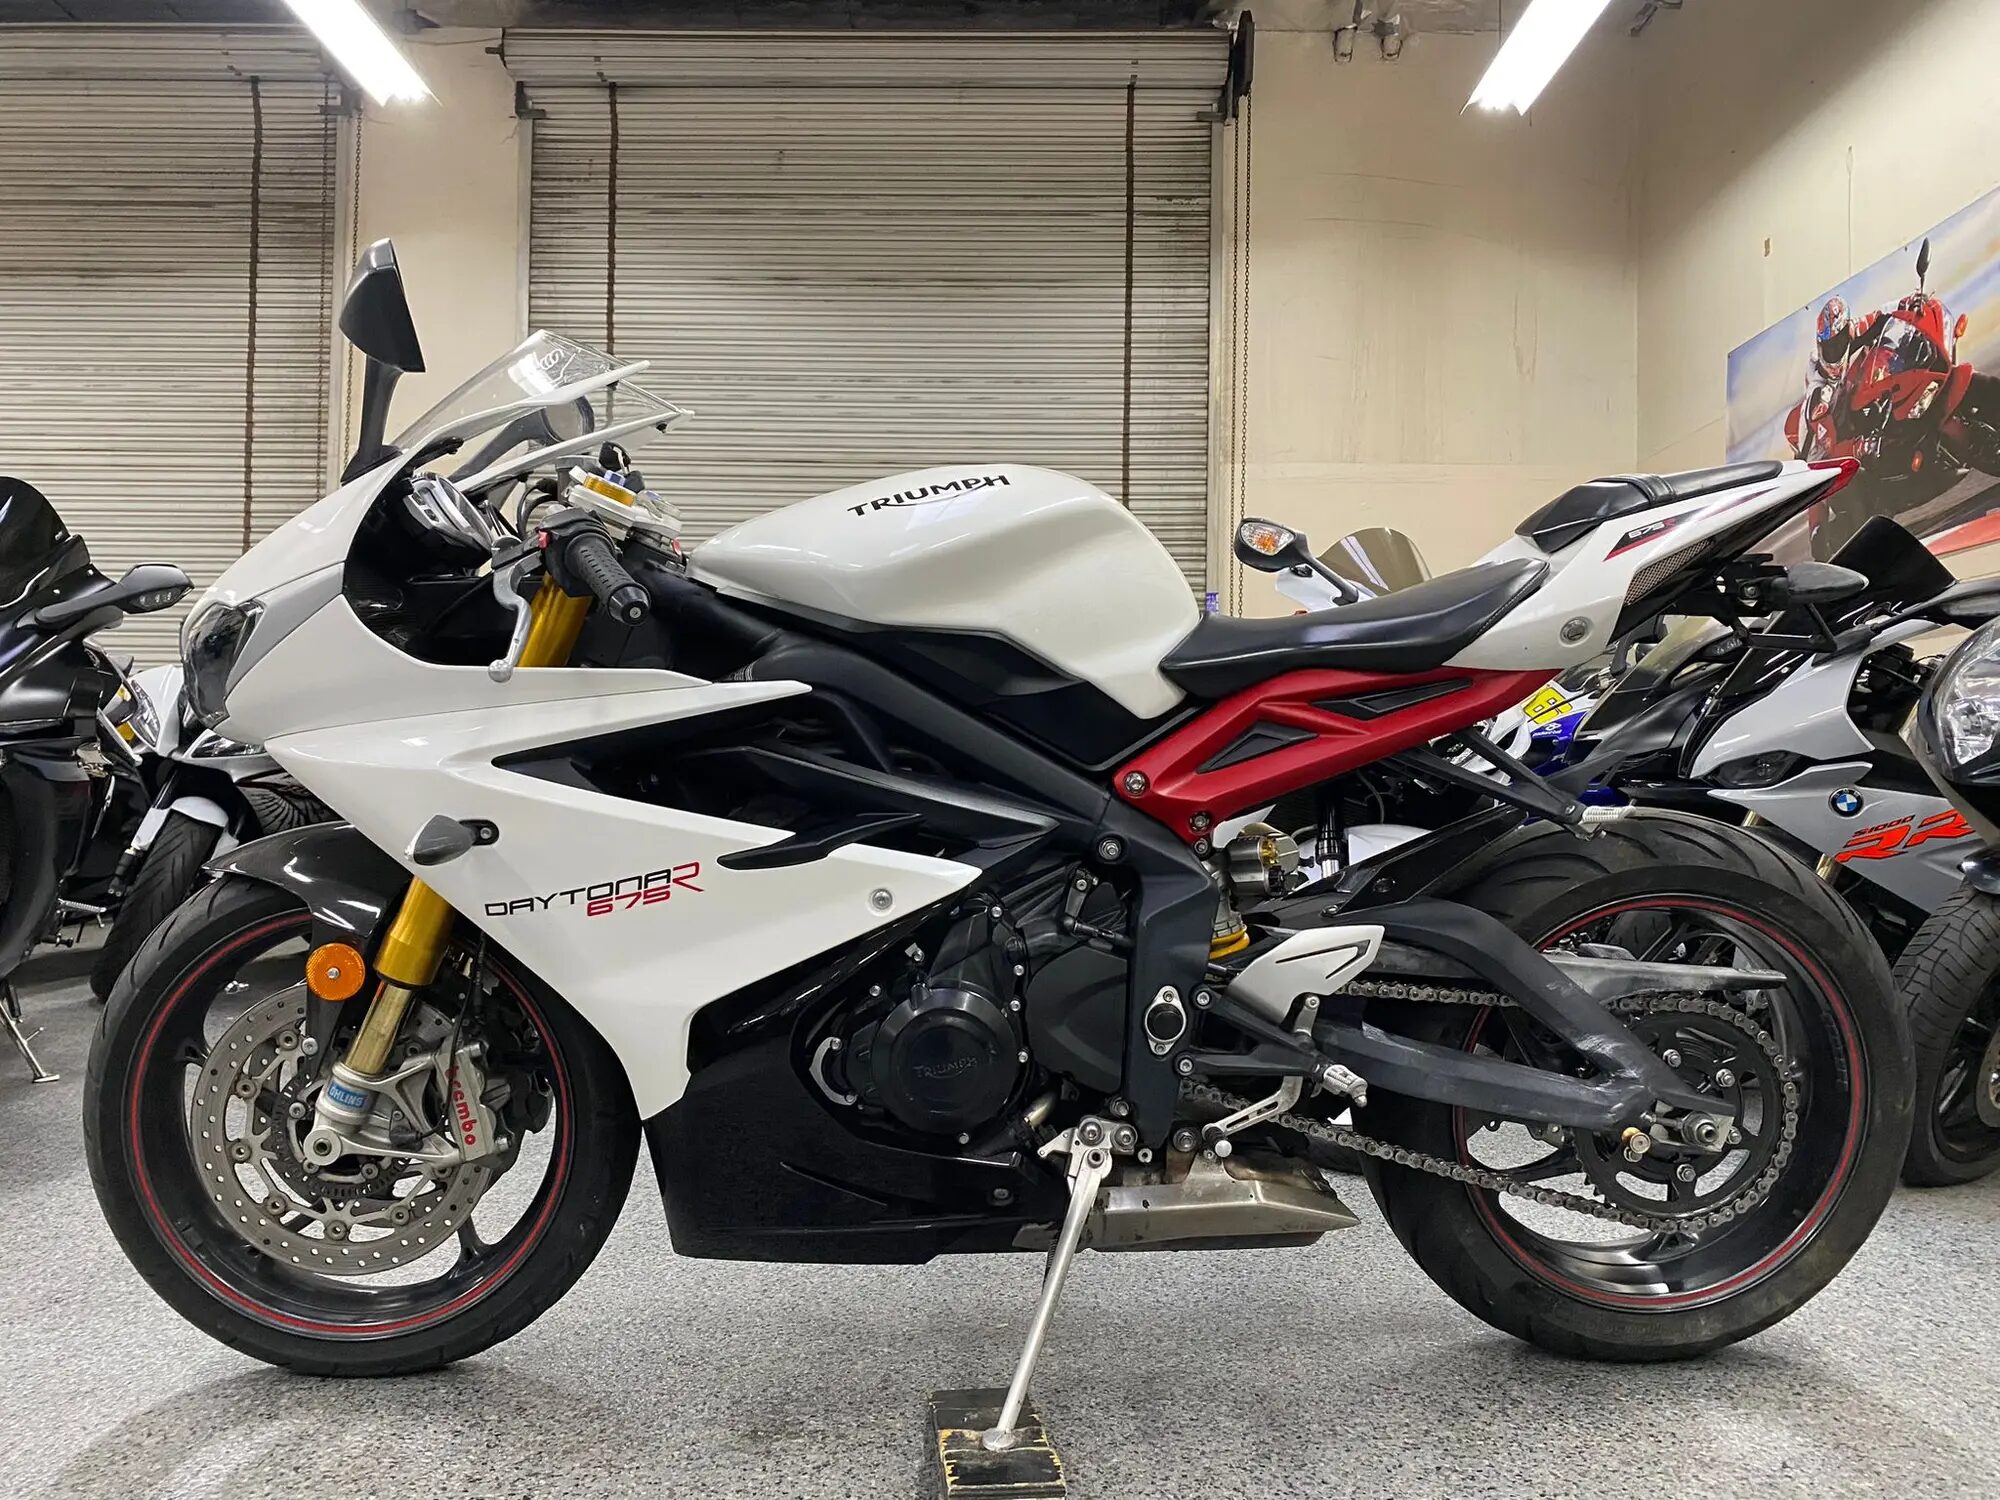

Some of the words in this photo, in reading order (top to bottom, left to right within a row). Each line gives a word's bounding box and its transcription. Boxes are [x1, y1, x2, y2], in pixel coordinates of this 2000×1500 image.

[847, 475, 1011, 516] TRIUMPH
[1852, 814, 1916, 838] S1000
[587, 885, 671, 917] 675
[913, 1056, 977, 1078] TRIUMPH
